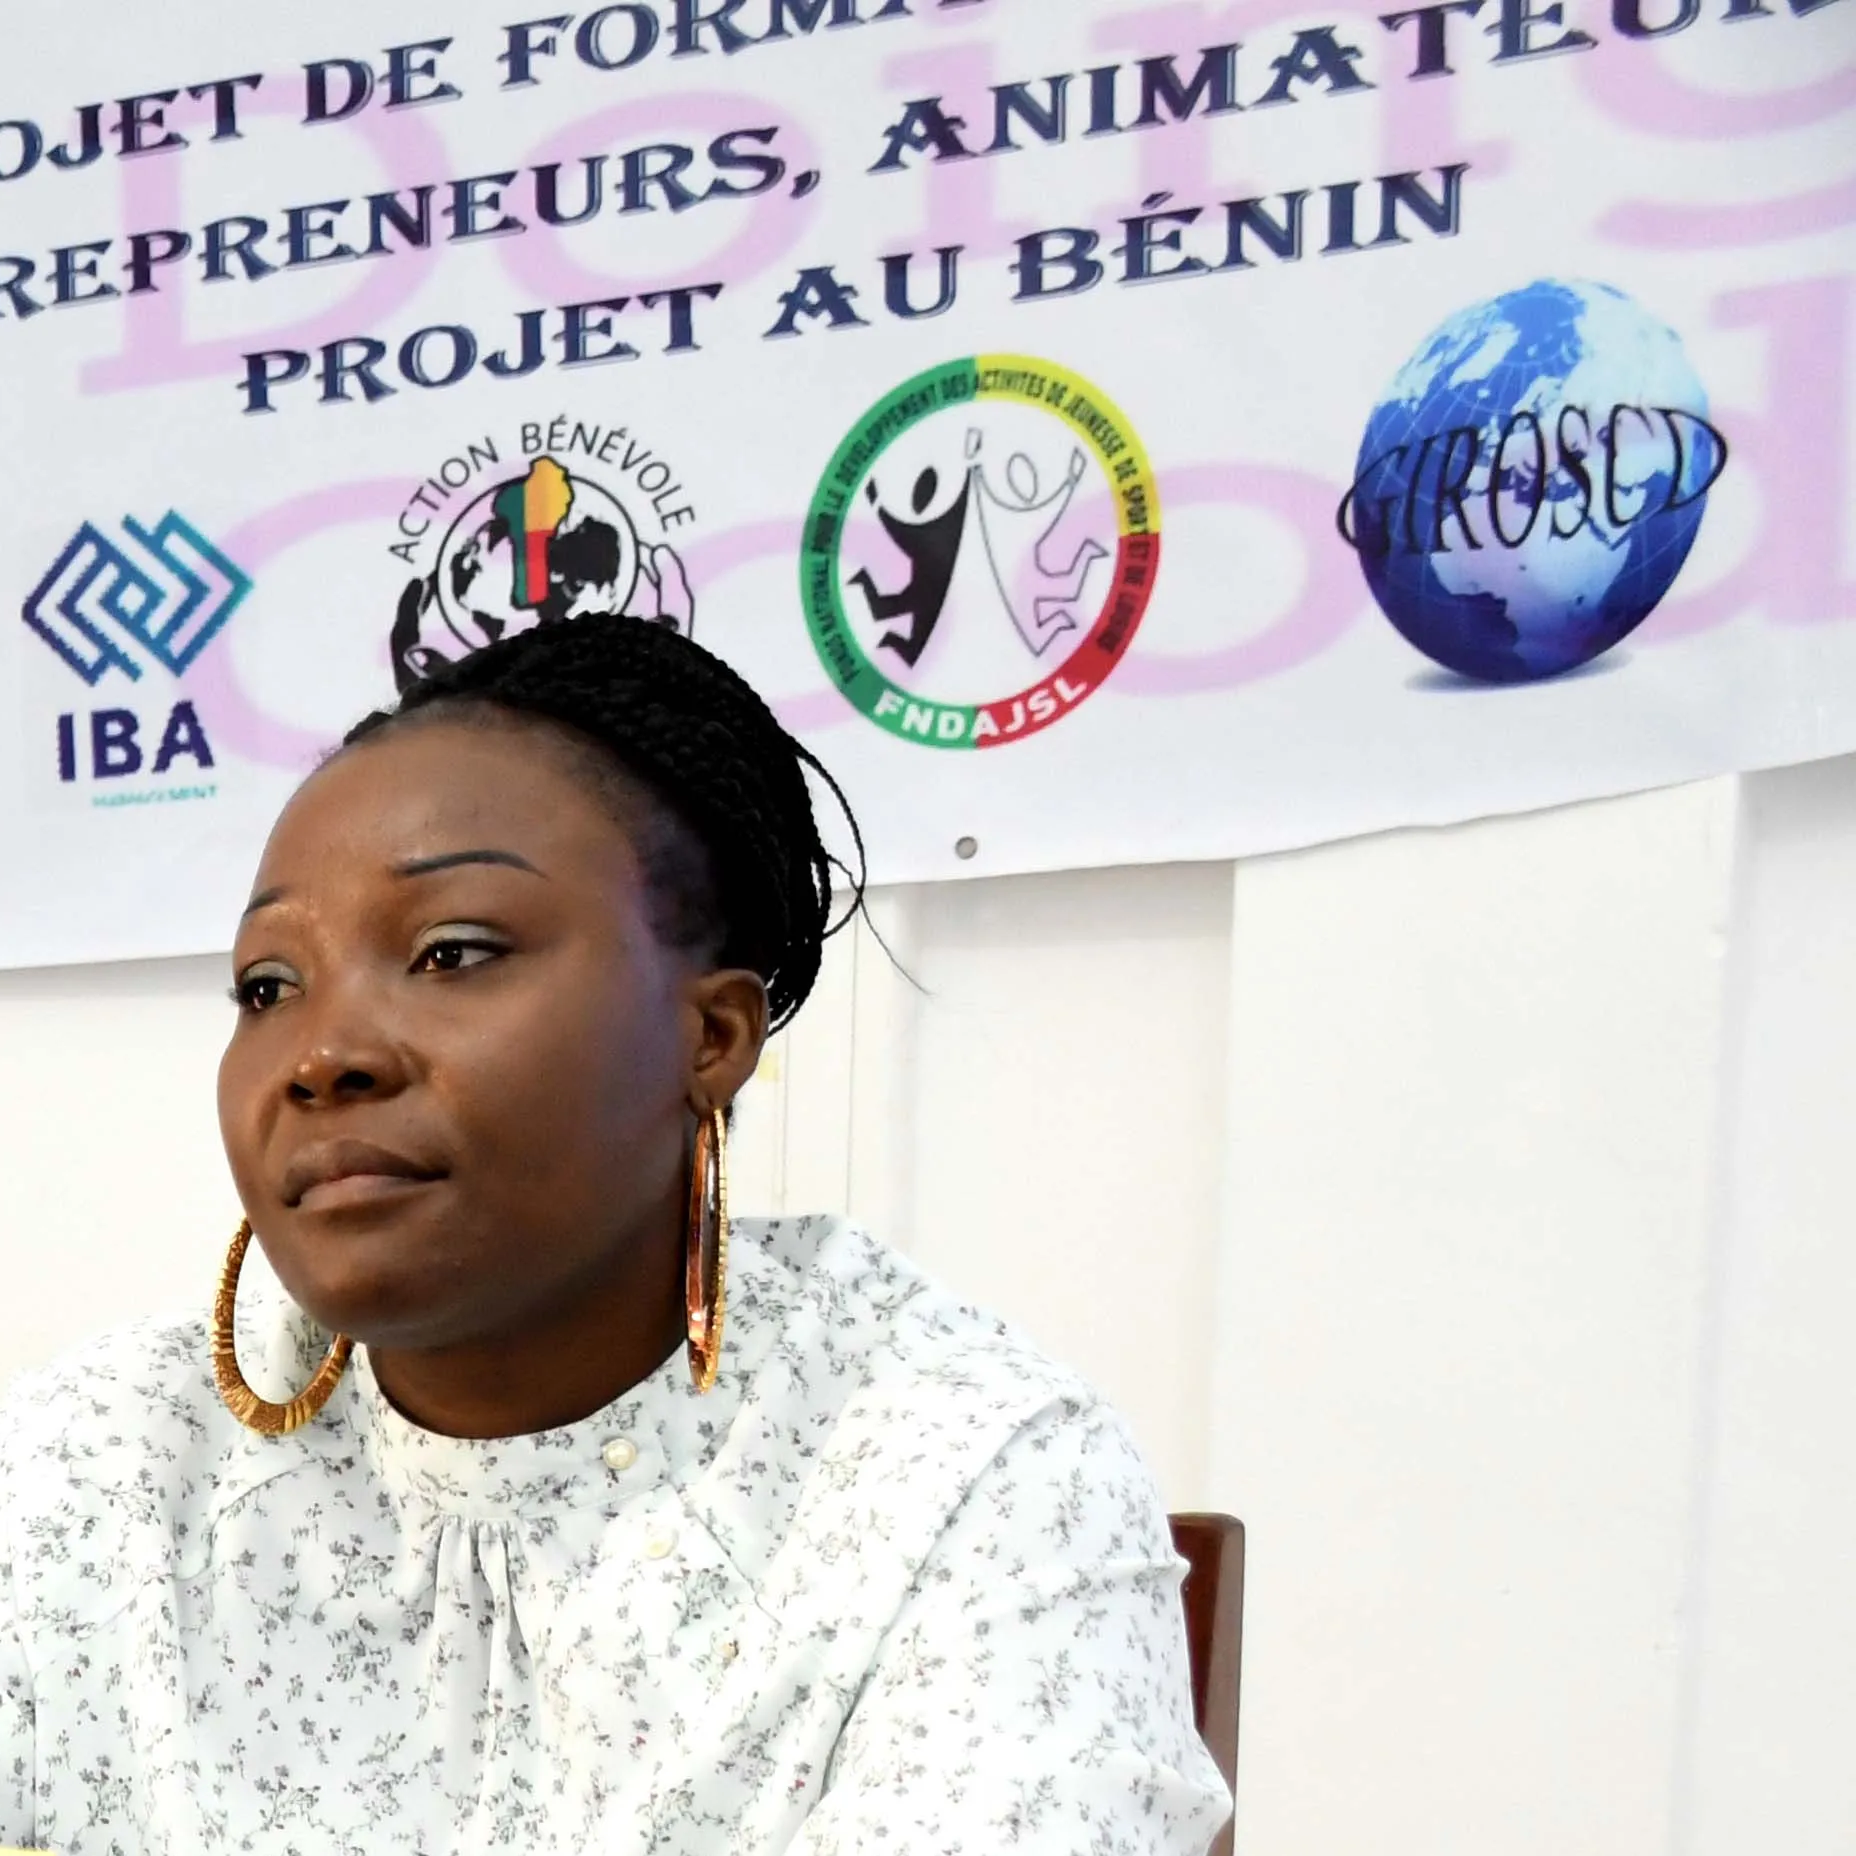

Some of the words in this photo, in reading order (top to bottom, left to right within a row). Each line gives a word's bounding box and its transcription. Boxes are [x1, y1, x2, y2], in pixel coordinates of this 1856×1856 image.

[301, 37, 463, 128] DE
[496, 0, 985, 92] FORM
[235, 283, 723, 415] PROJET
[761, 244, 966, 342] AU
[1010, 161, 1470, 305] BÉNIN
[388, 437, 500, 564] ACTION
[521, 413, 696, 532] BÉNÉVOLE
[1337, 403, 1728, 557] GIROSCD
[56, 699, 216, 782] IBA
[873, 675, 1088, 740] FNDAJSL
